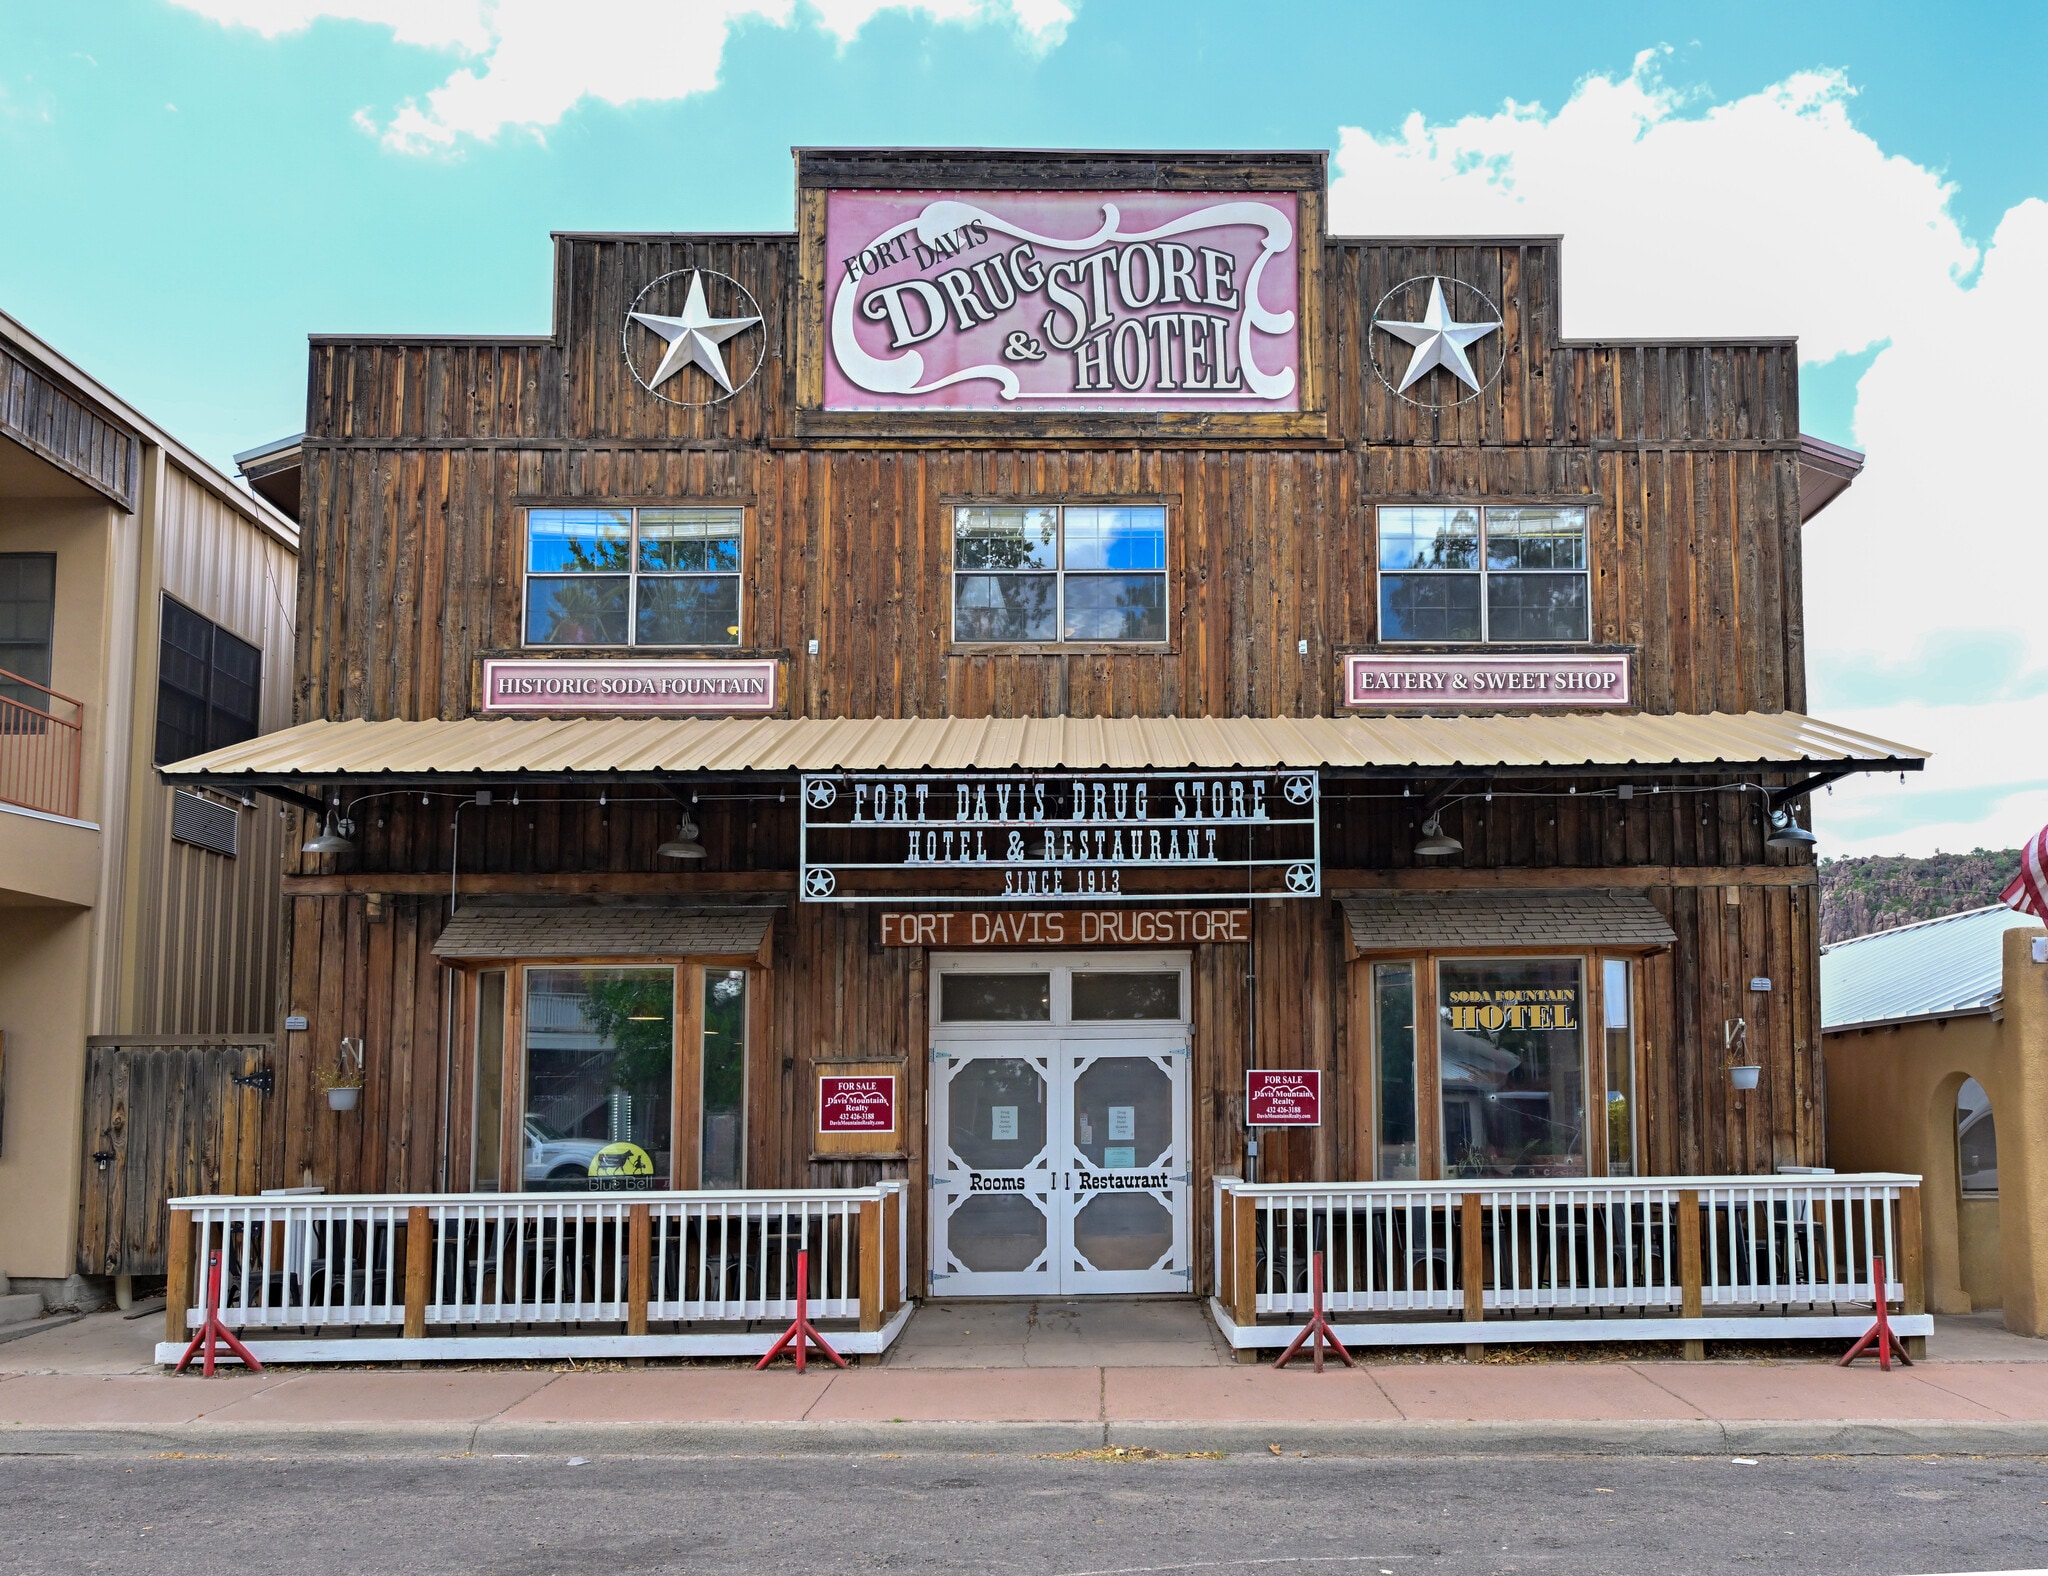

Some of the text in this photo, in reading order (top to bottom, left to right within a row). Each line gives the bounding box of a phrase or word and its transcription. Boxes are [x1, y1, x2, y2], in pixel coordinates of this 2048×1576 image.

[842, 219, 989, 285] FORT DAVIS
[862, 242, 1239, 351] DRUG STORE
[1004, 313, 1244, 391] & HOTEL
[497, 677, 765, 694] HISTORIC SODA FOUNTAIN
[1360, 672, 1616, 689] EATERY & SWEET SHOP
[853, 779, 1267, 821] FORT DAVIS DRUG STORE
[908, 828, 1218, 862] HOTEL & RESTAURANT
[1005, 869, 1121, 894] SINCE 1913
[881, 909, 1248, 944] FORT DAVIS DRUGSTORE
[1449, 989, 1575, 1002] SODA FOUNTAIN
[1450, 1004, 1577, 1032] HOTEL
[838, 1082, 876, 1090] FOR SALE
[588, 1177, 620, 1191] Blue
[625, 1176, 653, 1190] Bell
[969, 1171, 1168, 1190] Rooms Restaurant
